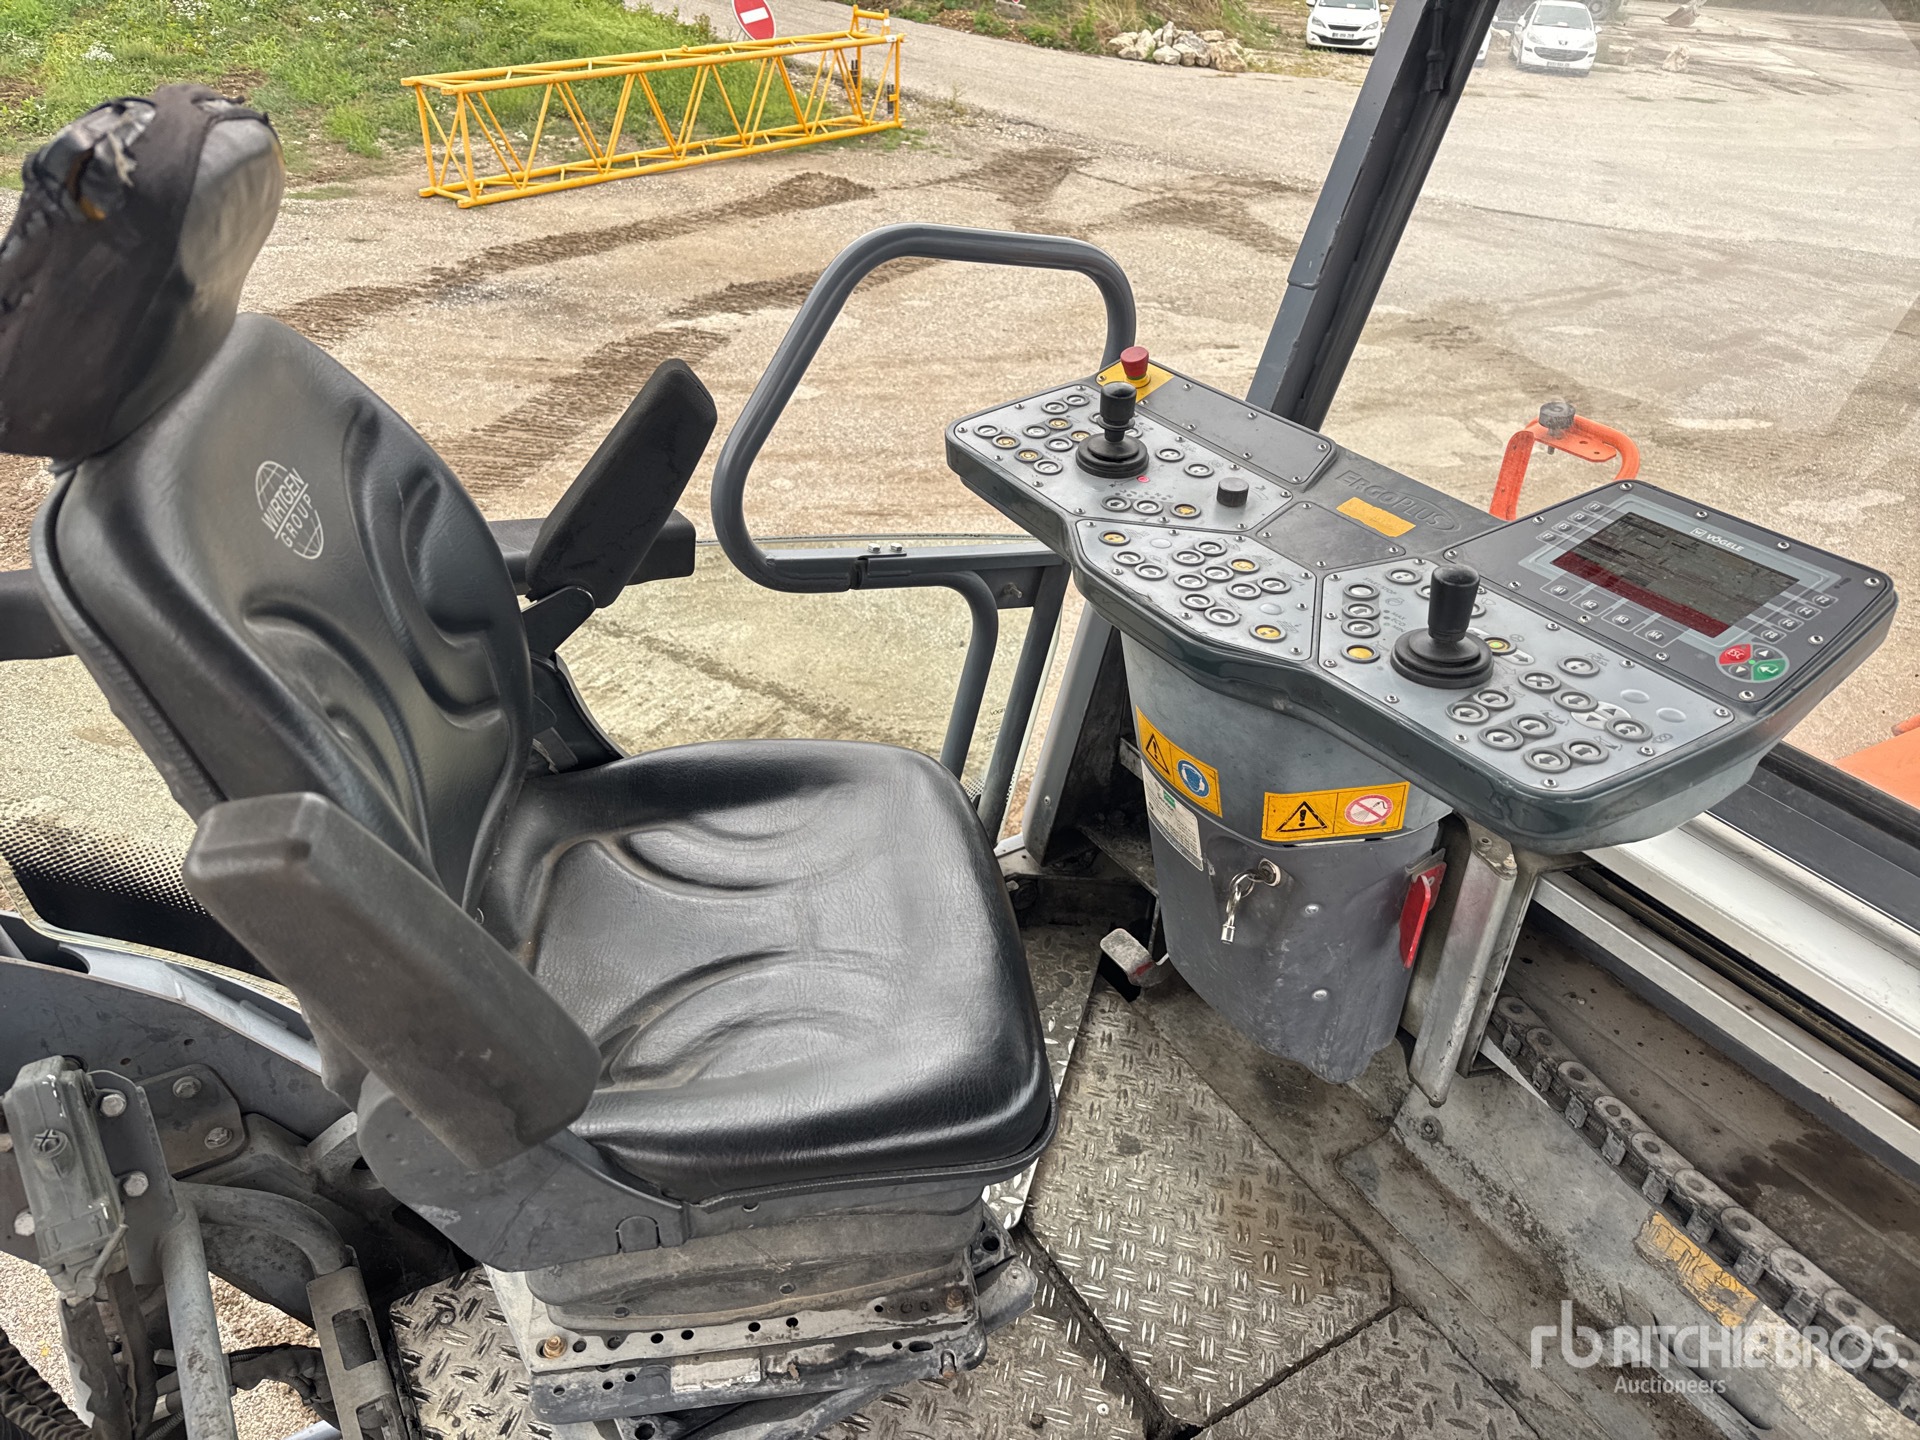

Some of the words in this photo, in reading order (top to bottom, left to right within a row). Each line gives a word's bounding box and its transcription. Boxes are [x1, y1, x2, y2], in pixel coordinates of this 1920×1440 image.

[261, 467, 305, 532] WIRTGEN
[1335, 470, 1446, 526] ERGOPLUS
[280, 493, 313, 548] GROUP
[1706, 533, 1745, 552] VÖGELE
[1554, 586, 1567, 594] M1
[1583, 600, 1598, 609] M2
[1799, 606, 1813, 616] F4
[1615, 614, 1630, 624] M3
[1782, 618, 1795, 627] F6
[1648, 629, 1664, 639] M4
[1765, 629, 1779, 639] F8
[1727, 648, 1745, 659] ESC
